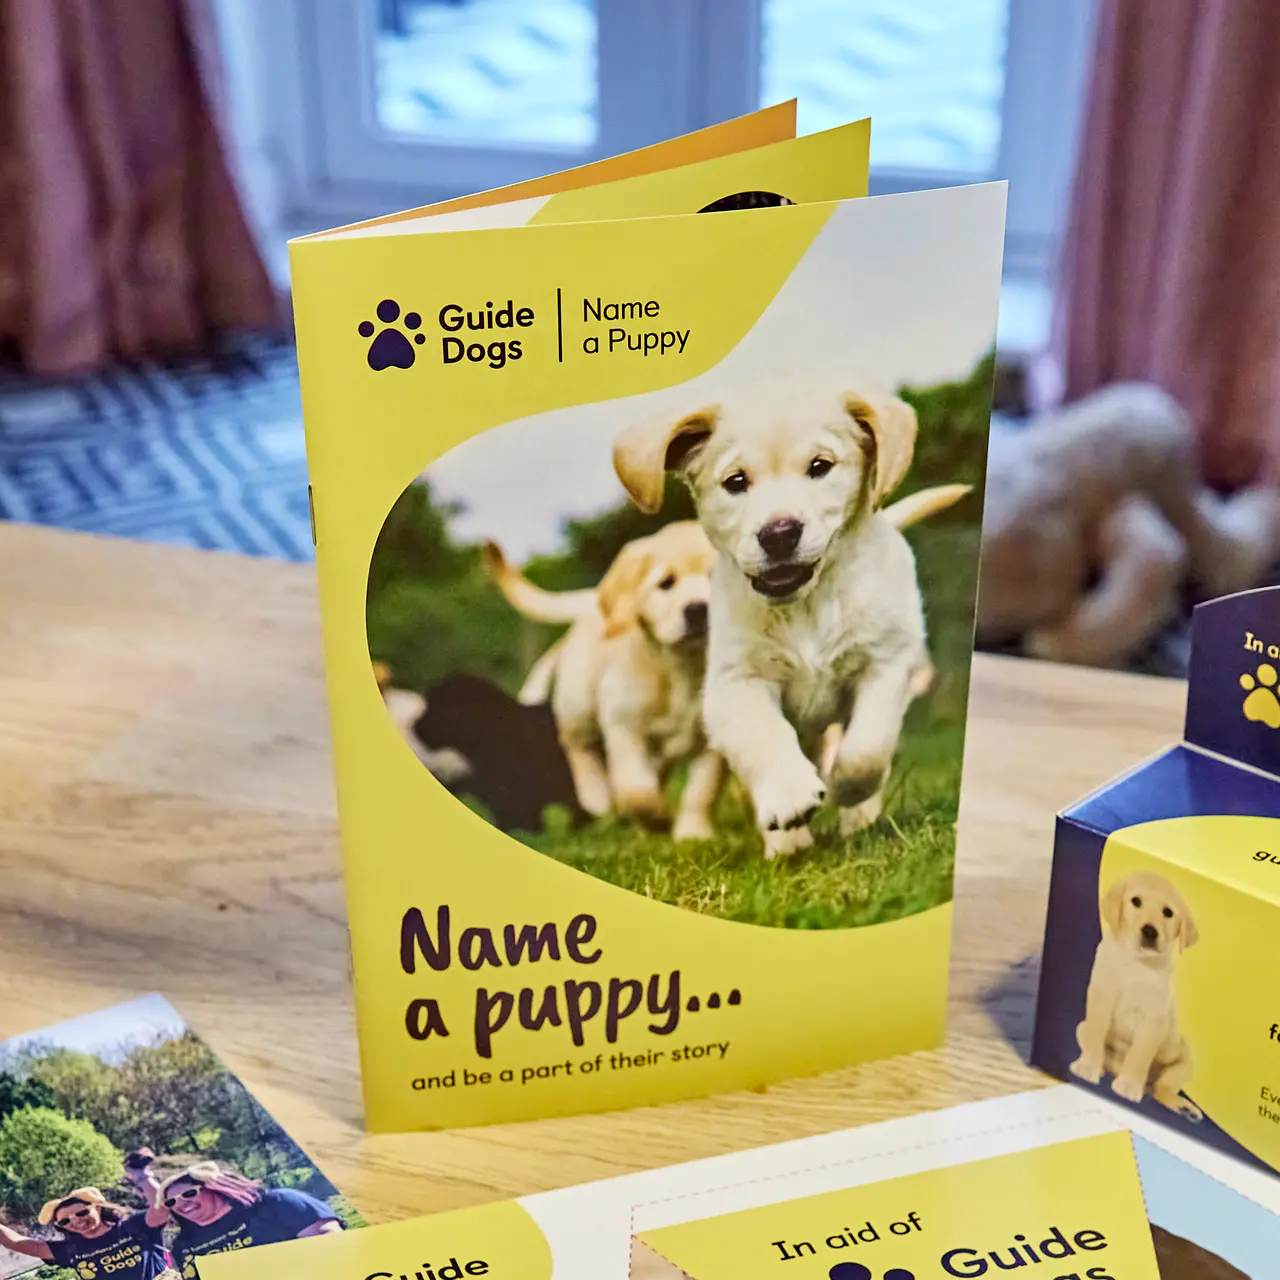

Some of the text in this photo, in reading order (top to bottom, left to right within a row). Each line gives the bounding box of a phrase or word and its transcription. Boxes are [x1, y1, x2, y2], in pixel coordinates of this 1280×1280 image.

[439, 301, 535, 332] Guide
[583, 297, 660, 320] Name
[442, 337, 523, 369] Dogs
[583, 326, 691, 357] a Puppy
[1243, 632, 1264, 654] In
[400, 905, 603, 974] Name
[406, 970, 742, 1059] a puppy...
[412, 1041, 730, 1090] and be a part of their story
[772, 1212, 922, 1261] In aid of
[941, 1227, 1108, 1278] Guide
[100, 1245, 140, 1265] Guide
